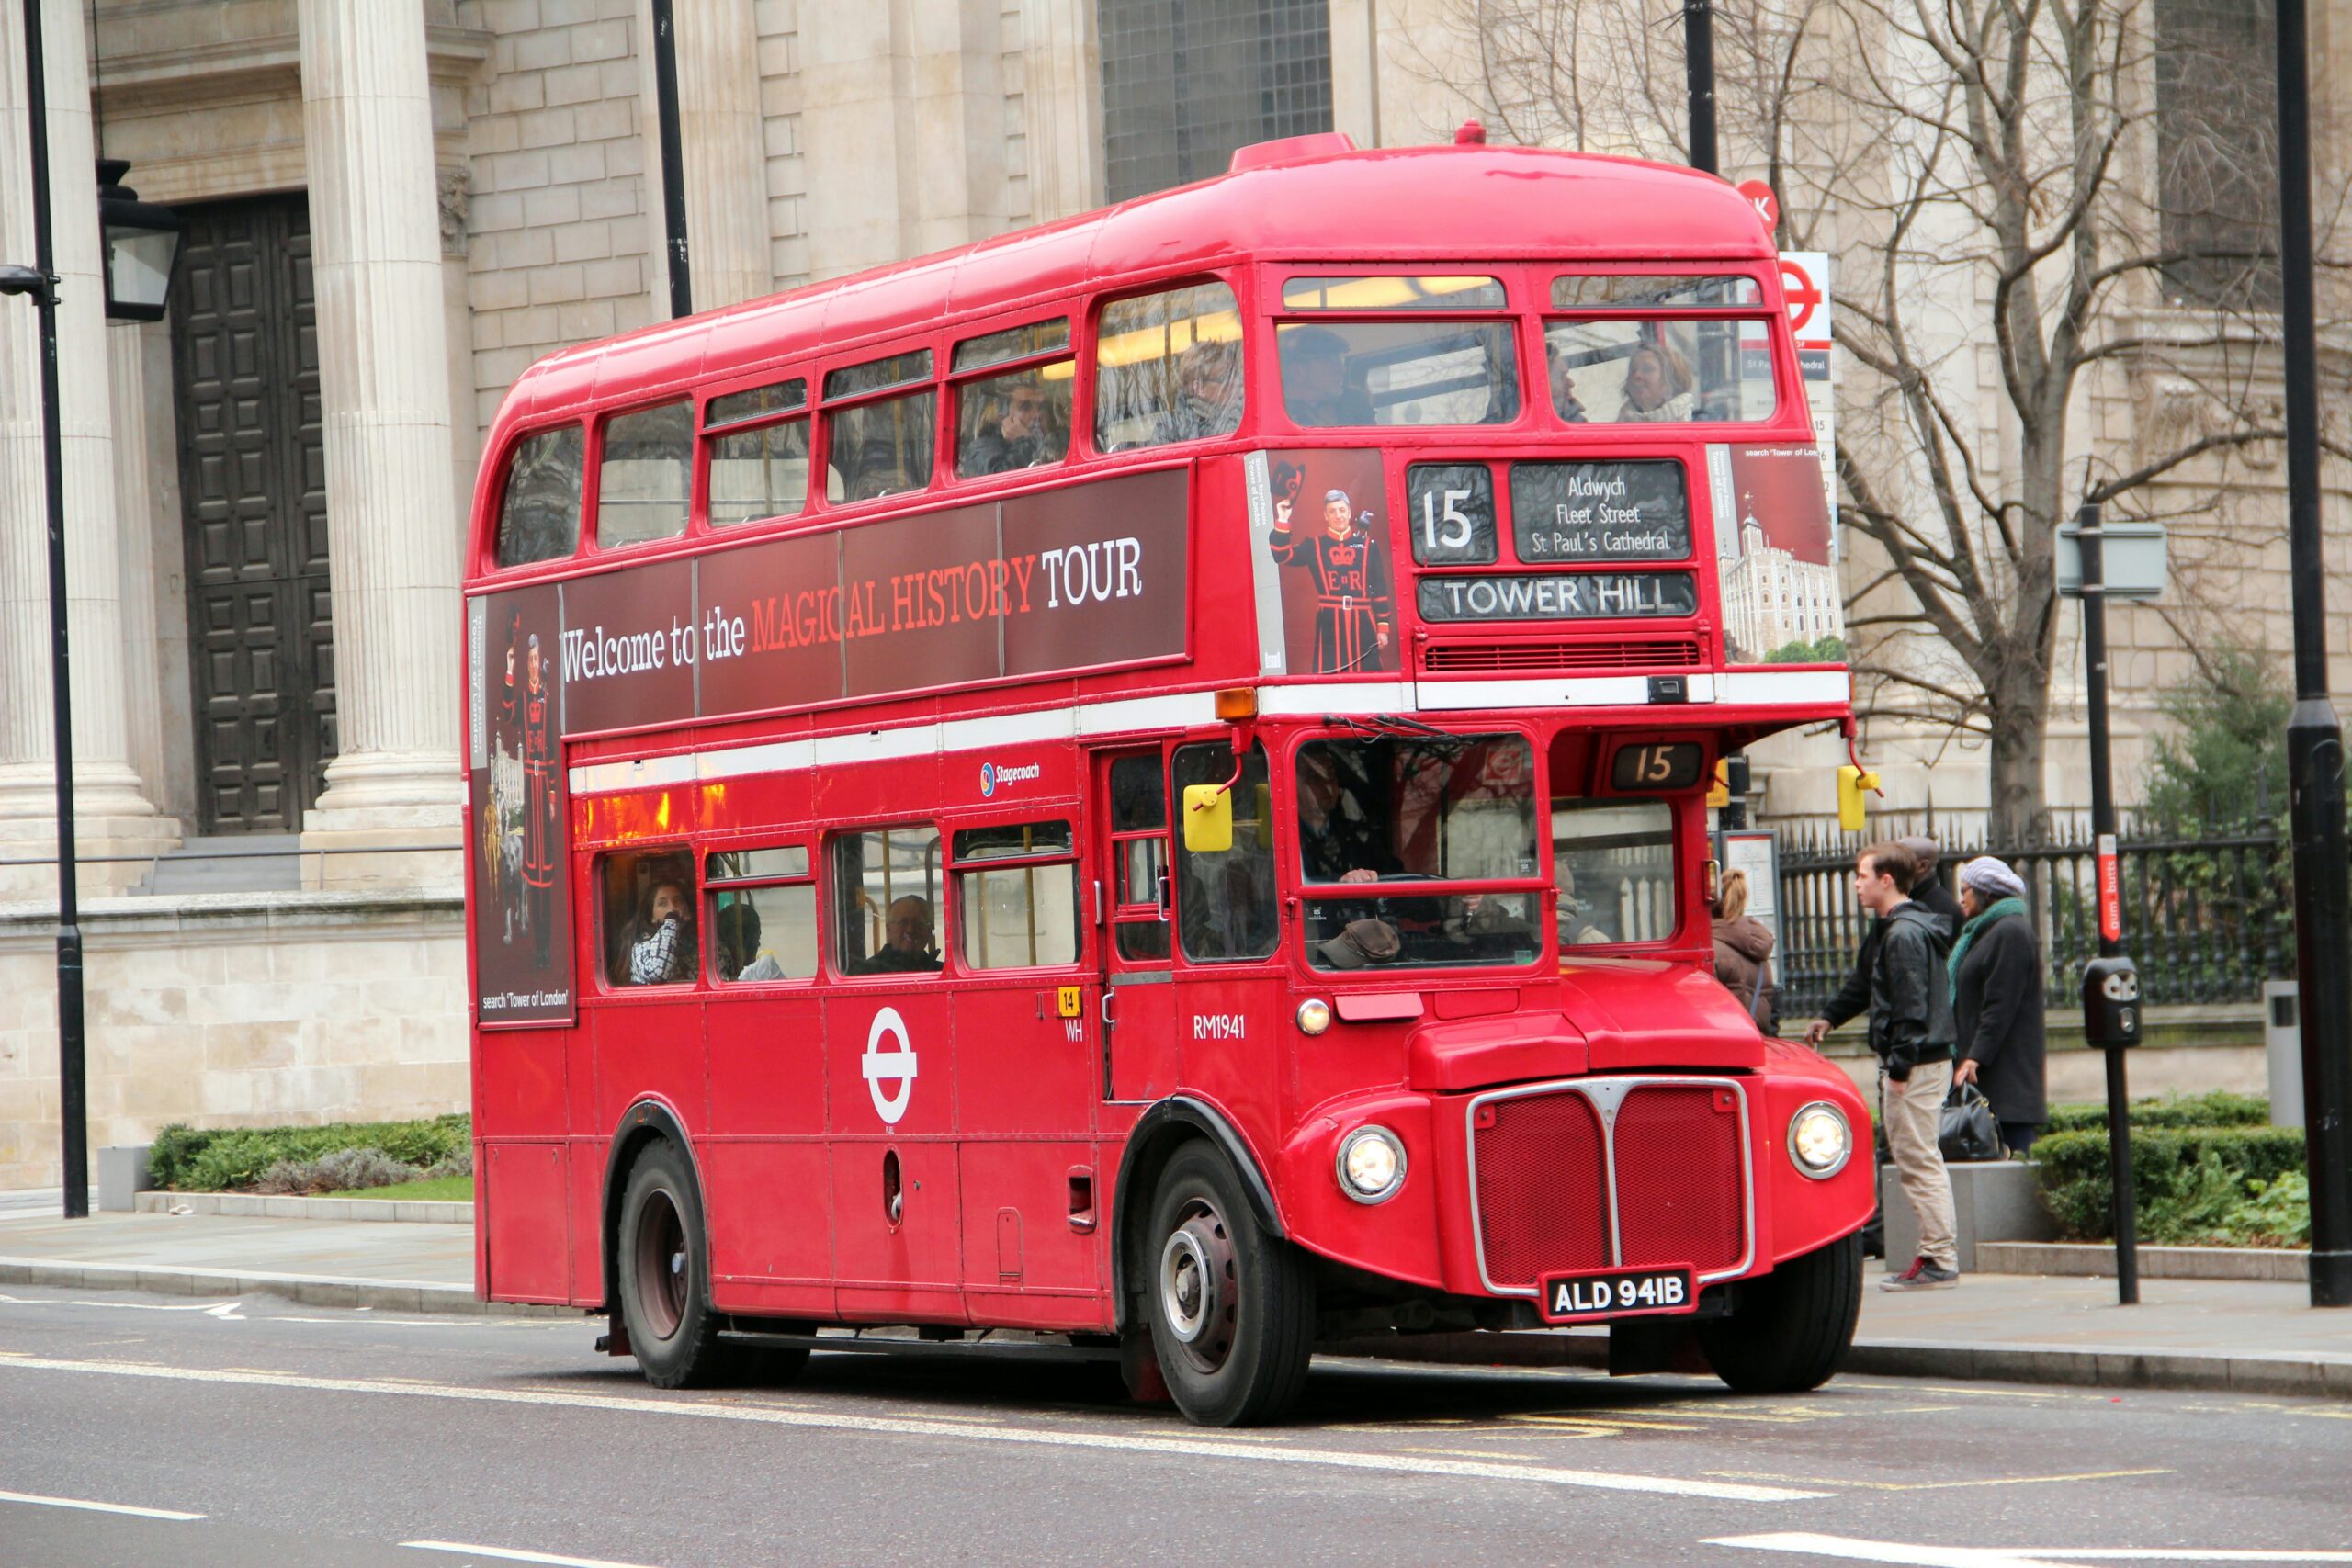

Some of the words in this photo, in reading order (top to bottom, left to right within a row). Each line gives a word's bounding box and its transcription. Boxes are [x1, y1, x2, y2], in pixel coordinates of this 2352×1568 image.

[1745, 448, 1770, 457] search
[1795, 447, 1803, 457] of
[1568, 476, 1626, 502] Aldwych
[1424, 490, 1472, 549] 15
[1556, 504, 1592, 525] Fleet
[1600, 503, 1642, 524] Street
[1532, 532, 1547, 553] St
[1554, 530, 1598, 552] Paul's
[1603, 530, 1671, 551] Cathedral
[559, 626, 665, 682] Welcome
[670, 615, 695, 667] to
[704, 606, 745, 661] the
[752, 581, 885, 652] MAGICAL
[890, 554, 1036, 632] HISTORY
[1041, 536, 1142, 609] TOUR
[1444, 580, 1582, 614] TOWER
[1599, 578, 1676, 612] HILL
[996, 761, 1040, 786] Stagecoach
[1635, 745, 1675, 782] 15
[2106, 860, 2117, 894] butts
[2109, 901, 2120, 931] gum
[482, 992, 506, 1010] search
[531, 989, 539, 1007] of
[1064, 991, 1074, 1010] 14
[1065, 1019, 1083, 1043] WH
[1193, 1013, 1246, 1040] RM1941
[1555, 1280, 1612, 1313] ALD
[1617, 1275, 1685, 1307] 941B
